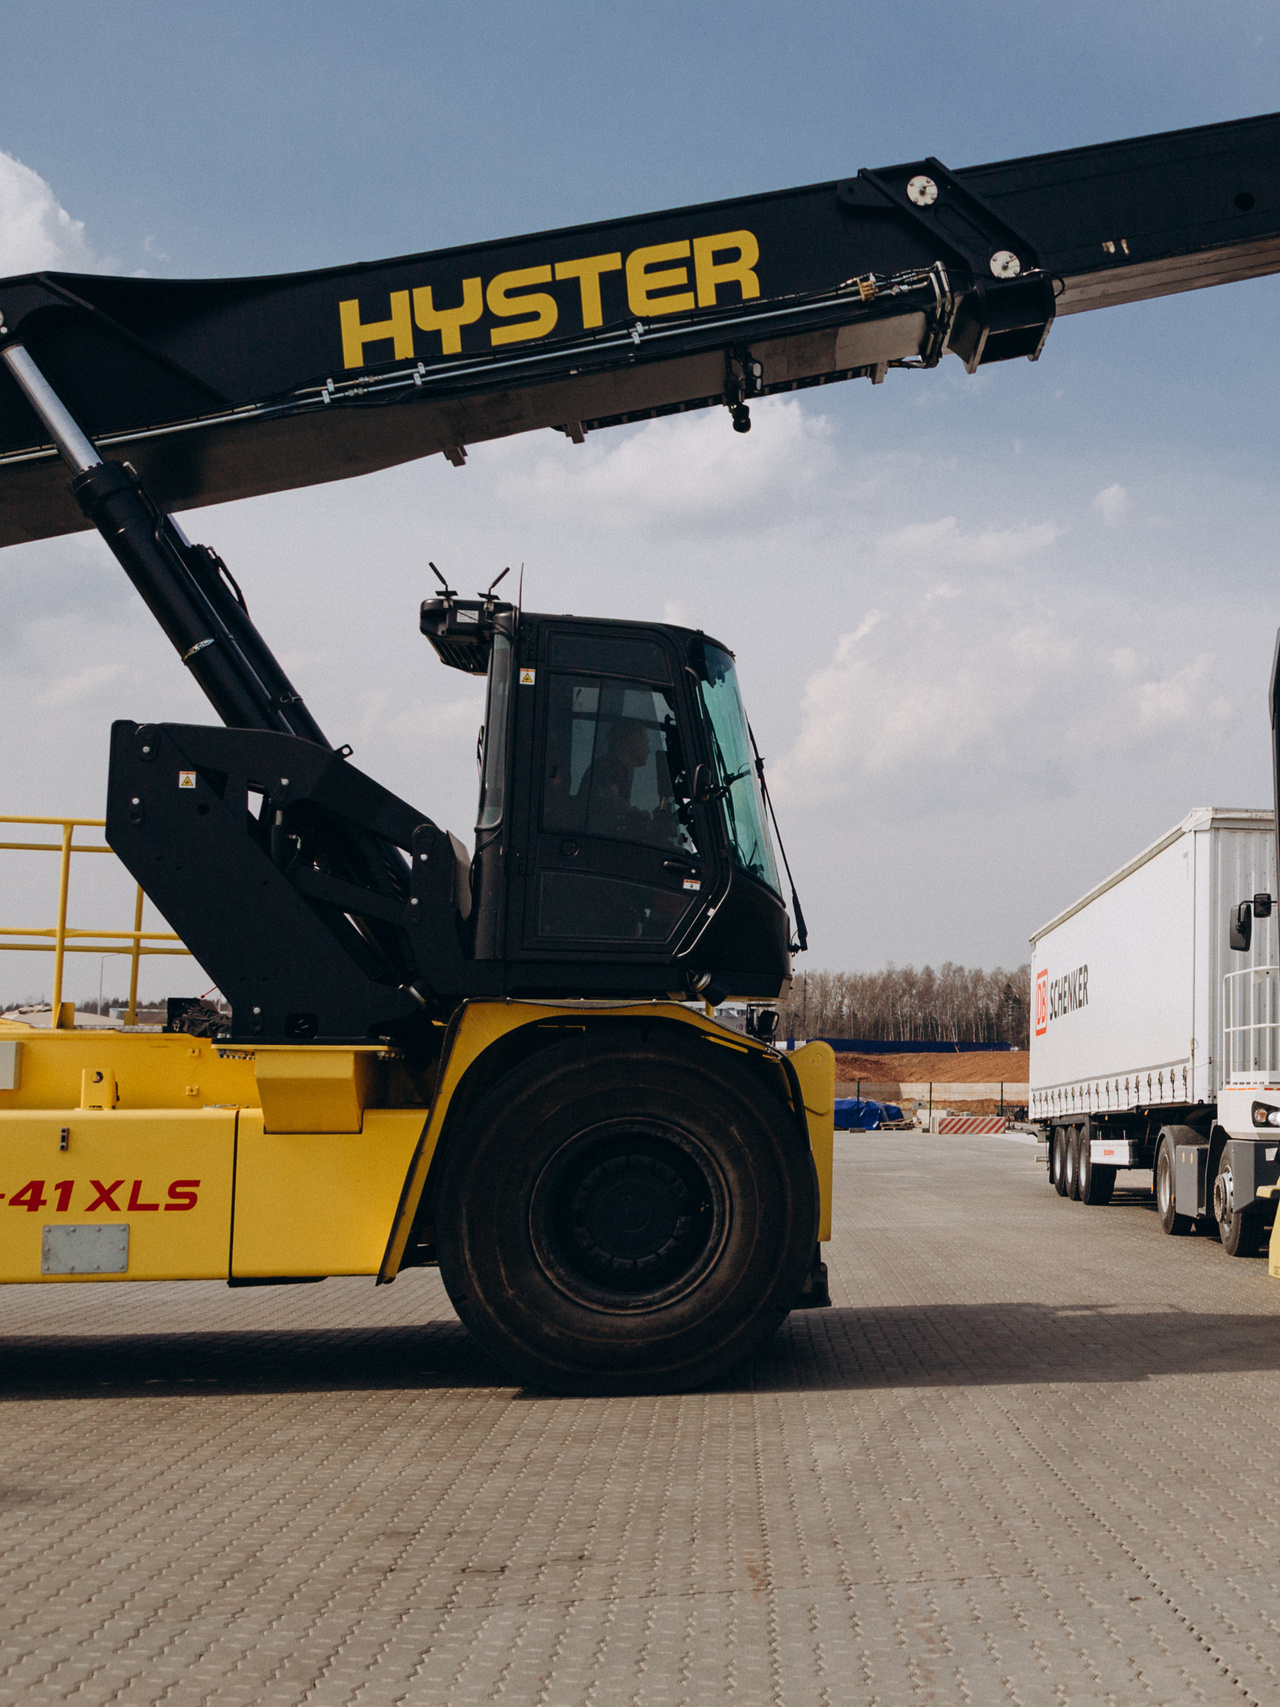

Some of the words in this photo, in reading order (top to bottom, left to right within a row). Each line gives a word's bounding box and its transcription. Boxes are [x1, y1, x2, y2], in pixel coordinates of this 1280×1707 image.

[339, 229, 760, 369] HYSTER
[1037, 980, 1046, 1026] DB
[1050, 964, 1088, 1021] SCHENKER
